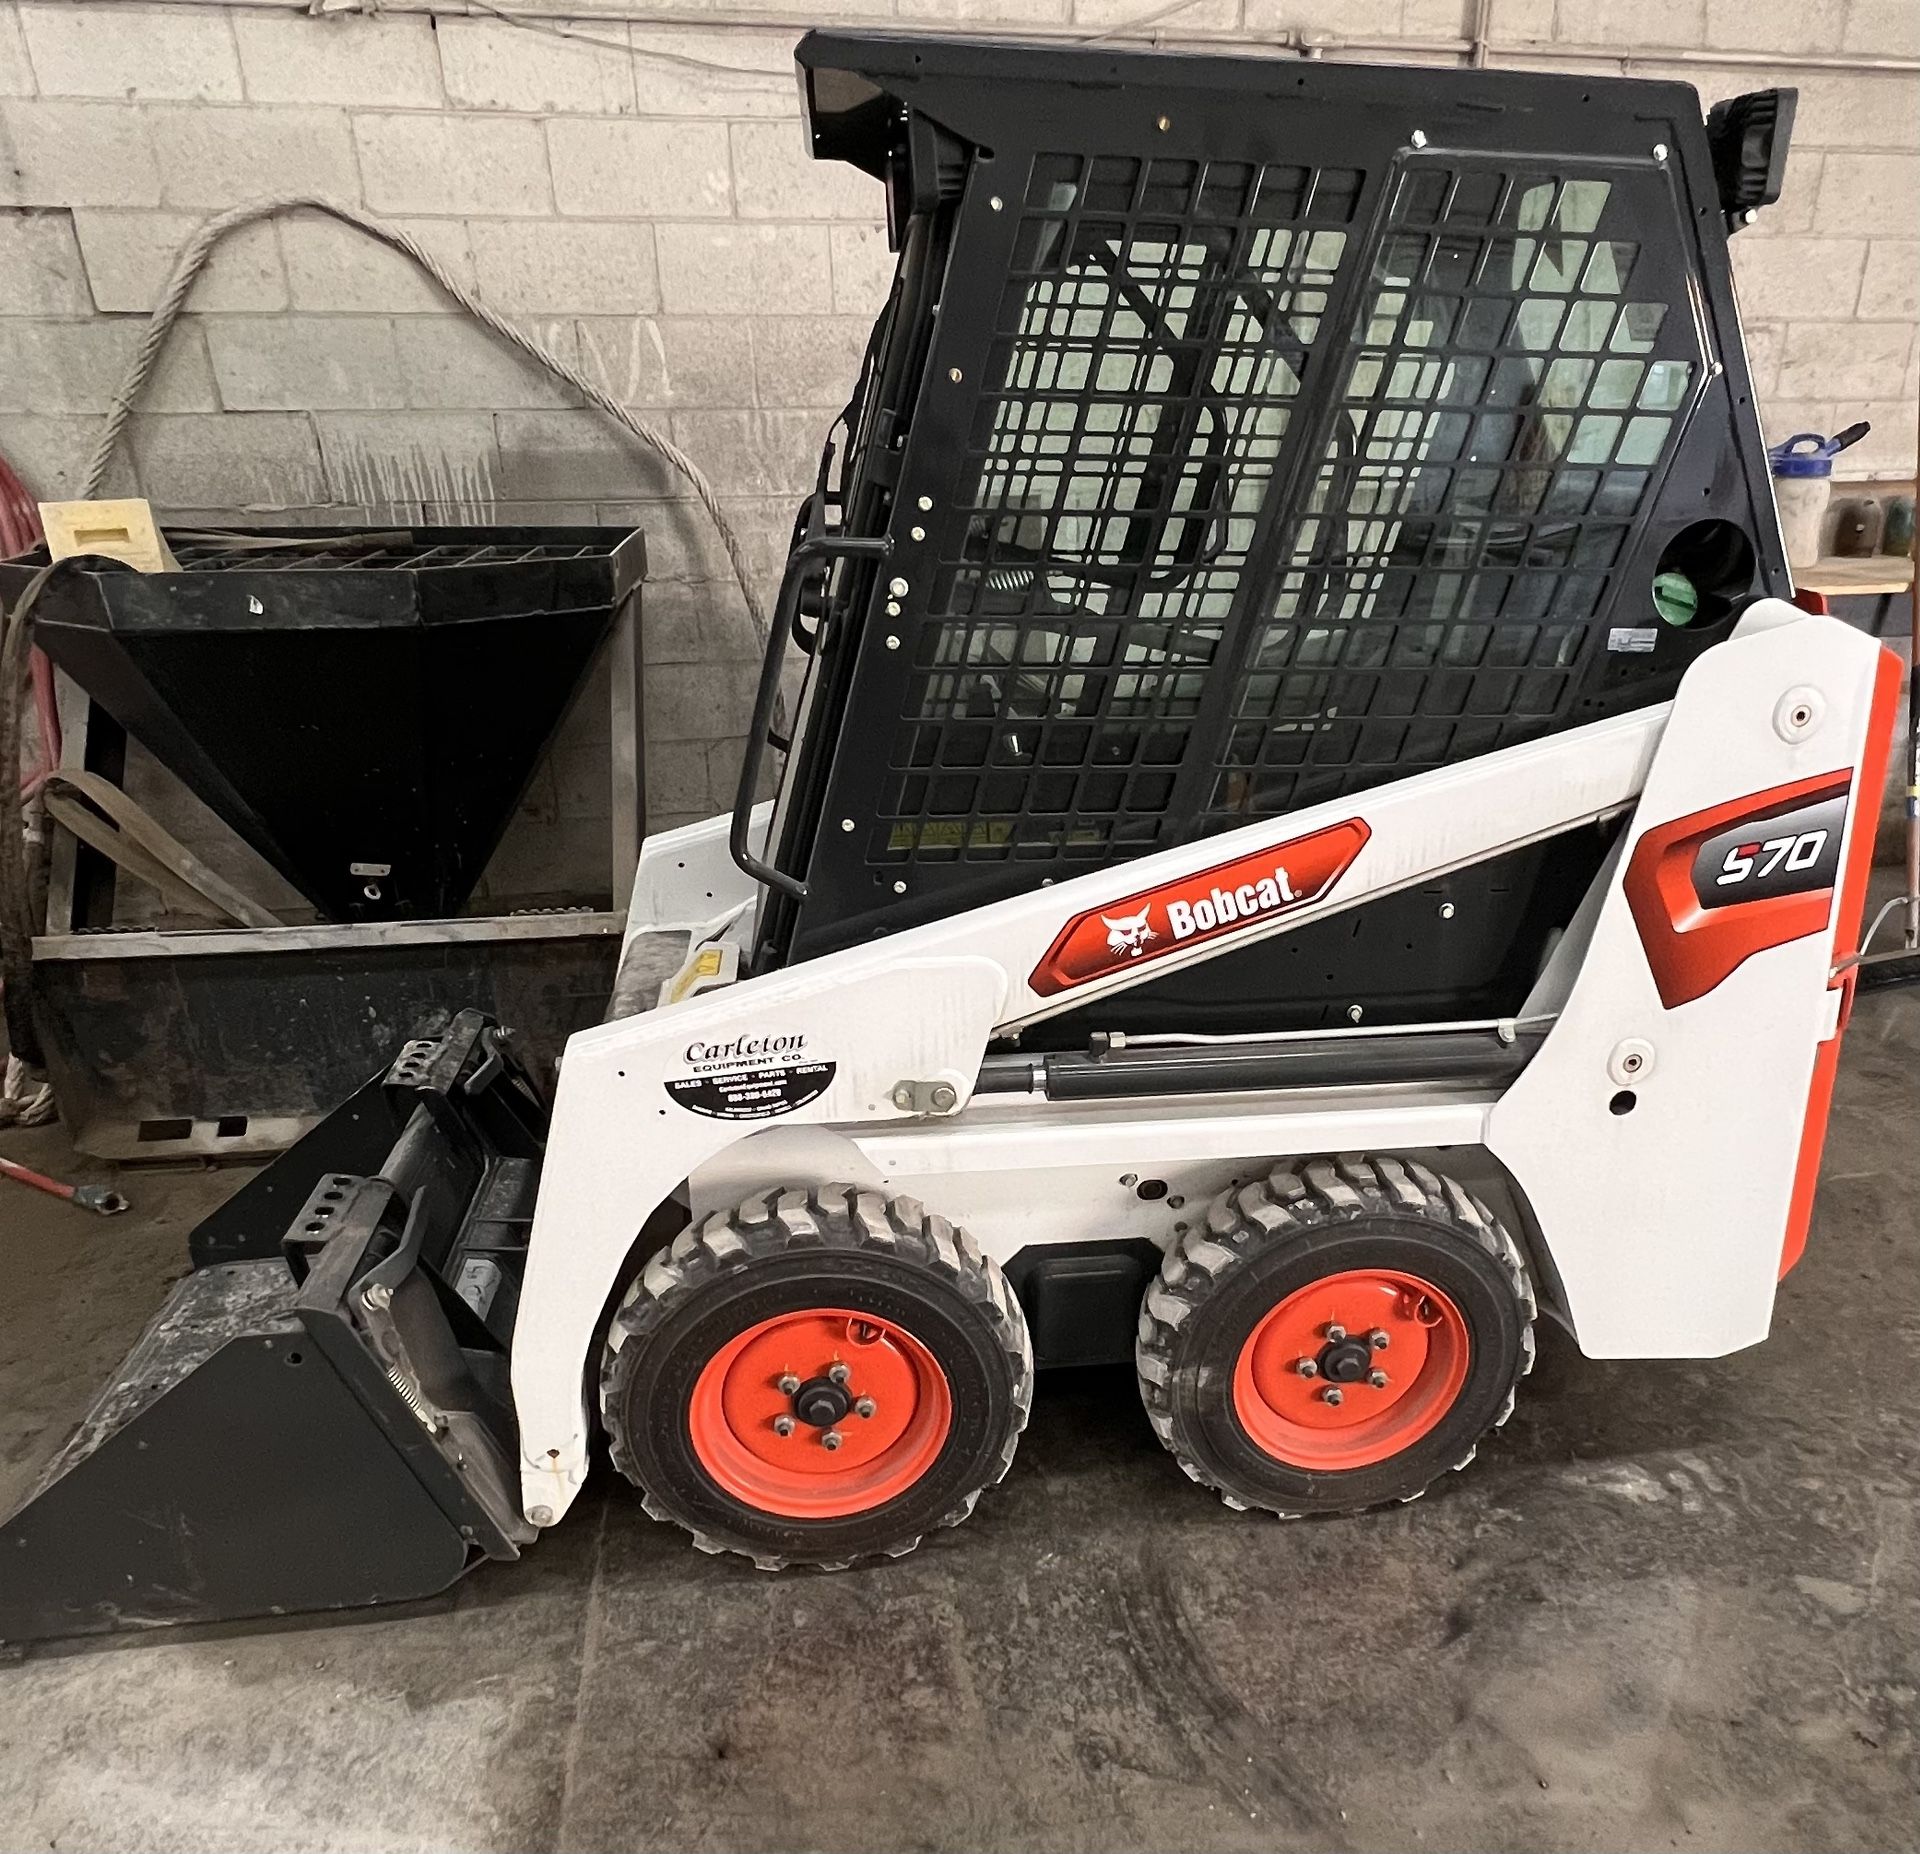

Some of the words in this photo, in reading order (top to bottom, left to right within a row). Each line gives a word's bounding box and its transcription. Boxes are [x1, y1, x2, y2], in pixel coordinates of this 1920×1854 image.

[1715, 829, 1828, 886] S70
[1166, 866, 1296, 940] Bobcat
[684, 1034, 806, 1064] Carleton
[674, 1080, 702, 1090] SALES
[712, 1074, 749, 1085] SERVICE
[758, 1069, 786, 1080] PARTS
[796, 1064, 829, 1075] RENTAL
[693, 1057, 774, 1073] EQUIPMENT
